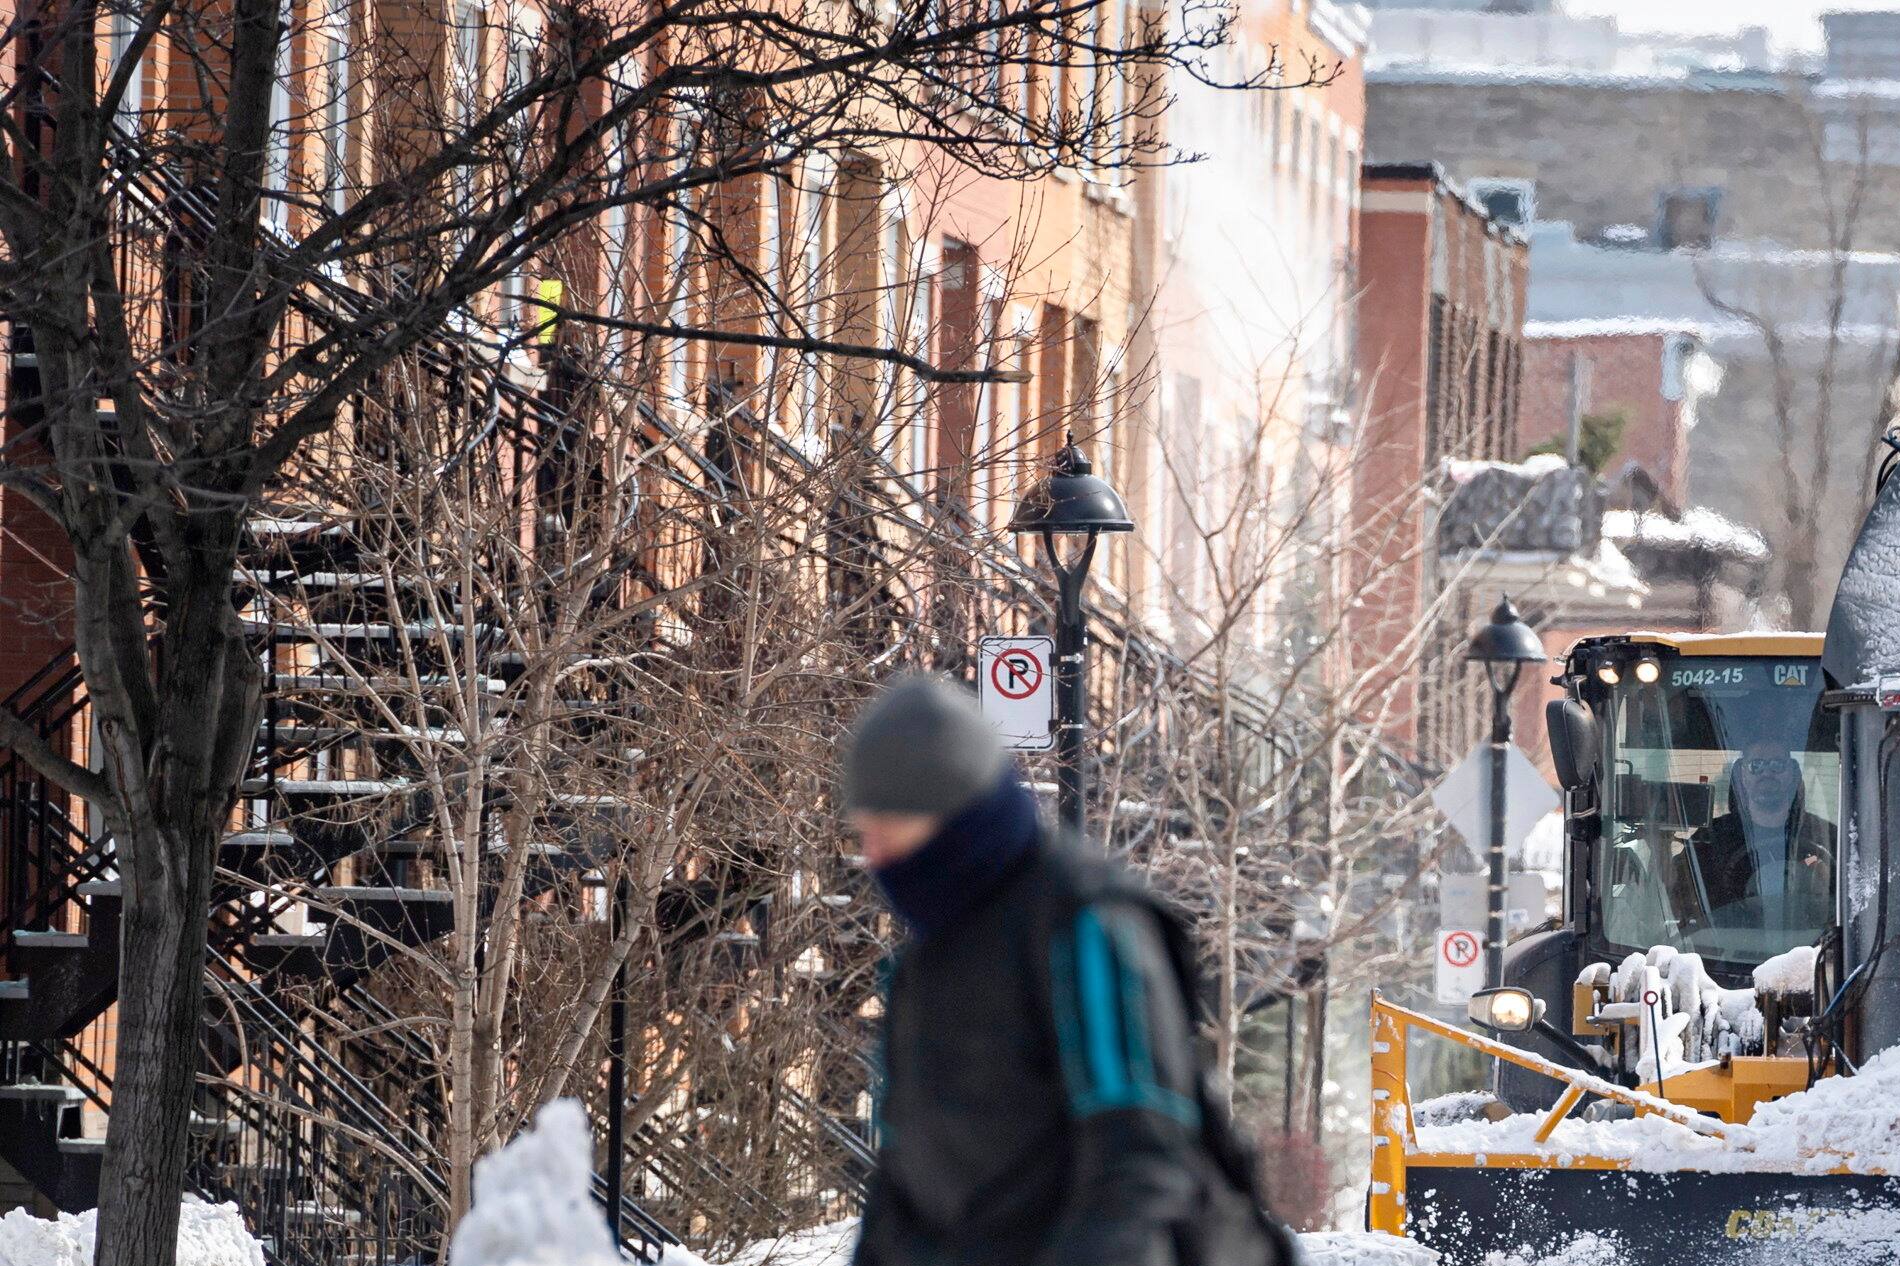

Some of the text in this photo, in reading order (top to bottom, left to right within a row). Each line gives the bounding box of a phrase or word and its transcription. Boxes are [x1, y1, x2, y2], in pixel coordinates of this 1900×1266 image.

[1008, 659, 1029, 689] P
[1671, 668, 1744, 687] 5042-15
[1774, 664, 1808, 686] CAT
